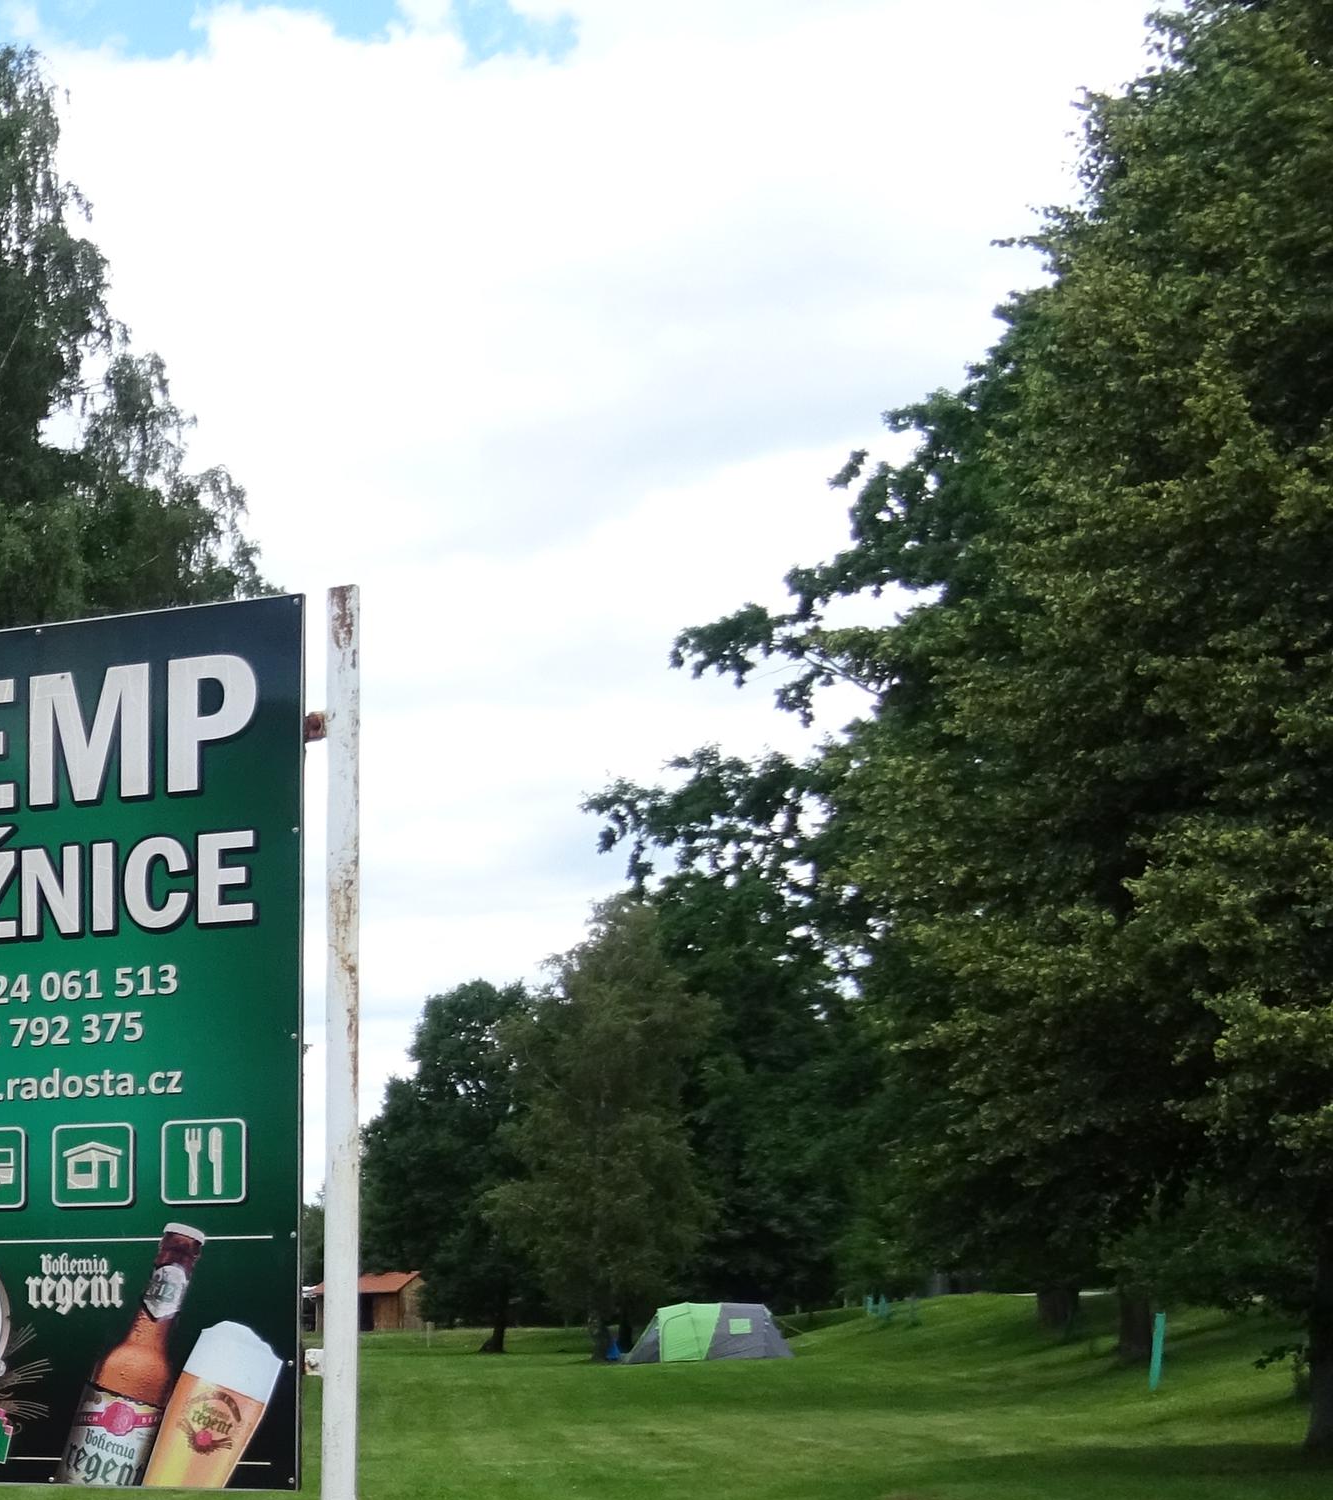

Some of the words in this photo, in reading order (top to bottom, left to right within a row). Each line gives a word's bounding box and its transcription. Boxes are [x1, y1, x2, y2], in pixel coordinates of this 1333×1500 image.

[40, 970, 102, 1001] 061
[115, 965, 178, 996] 513
[9, 1016, 71, 1047] 792
[81, 1012, 143, 1043] 375
[40, 1253, 108, 1275] Bohemia
[25, 1271, 124, 1315] regent
